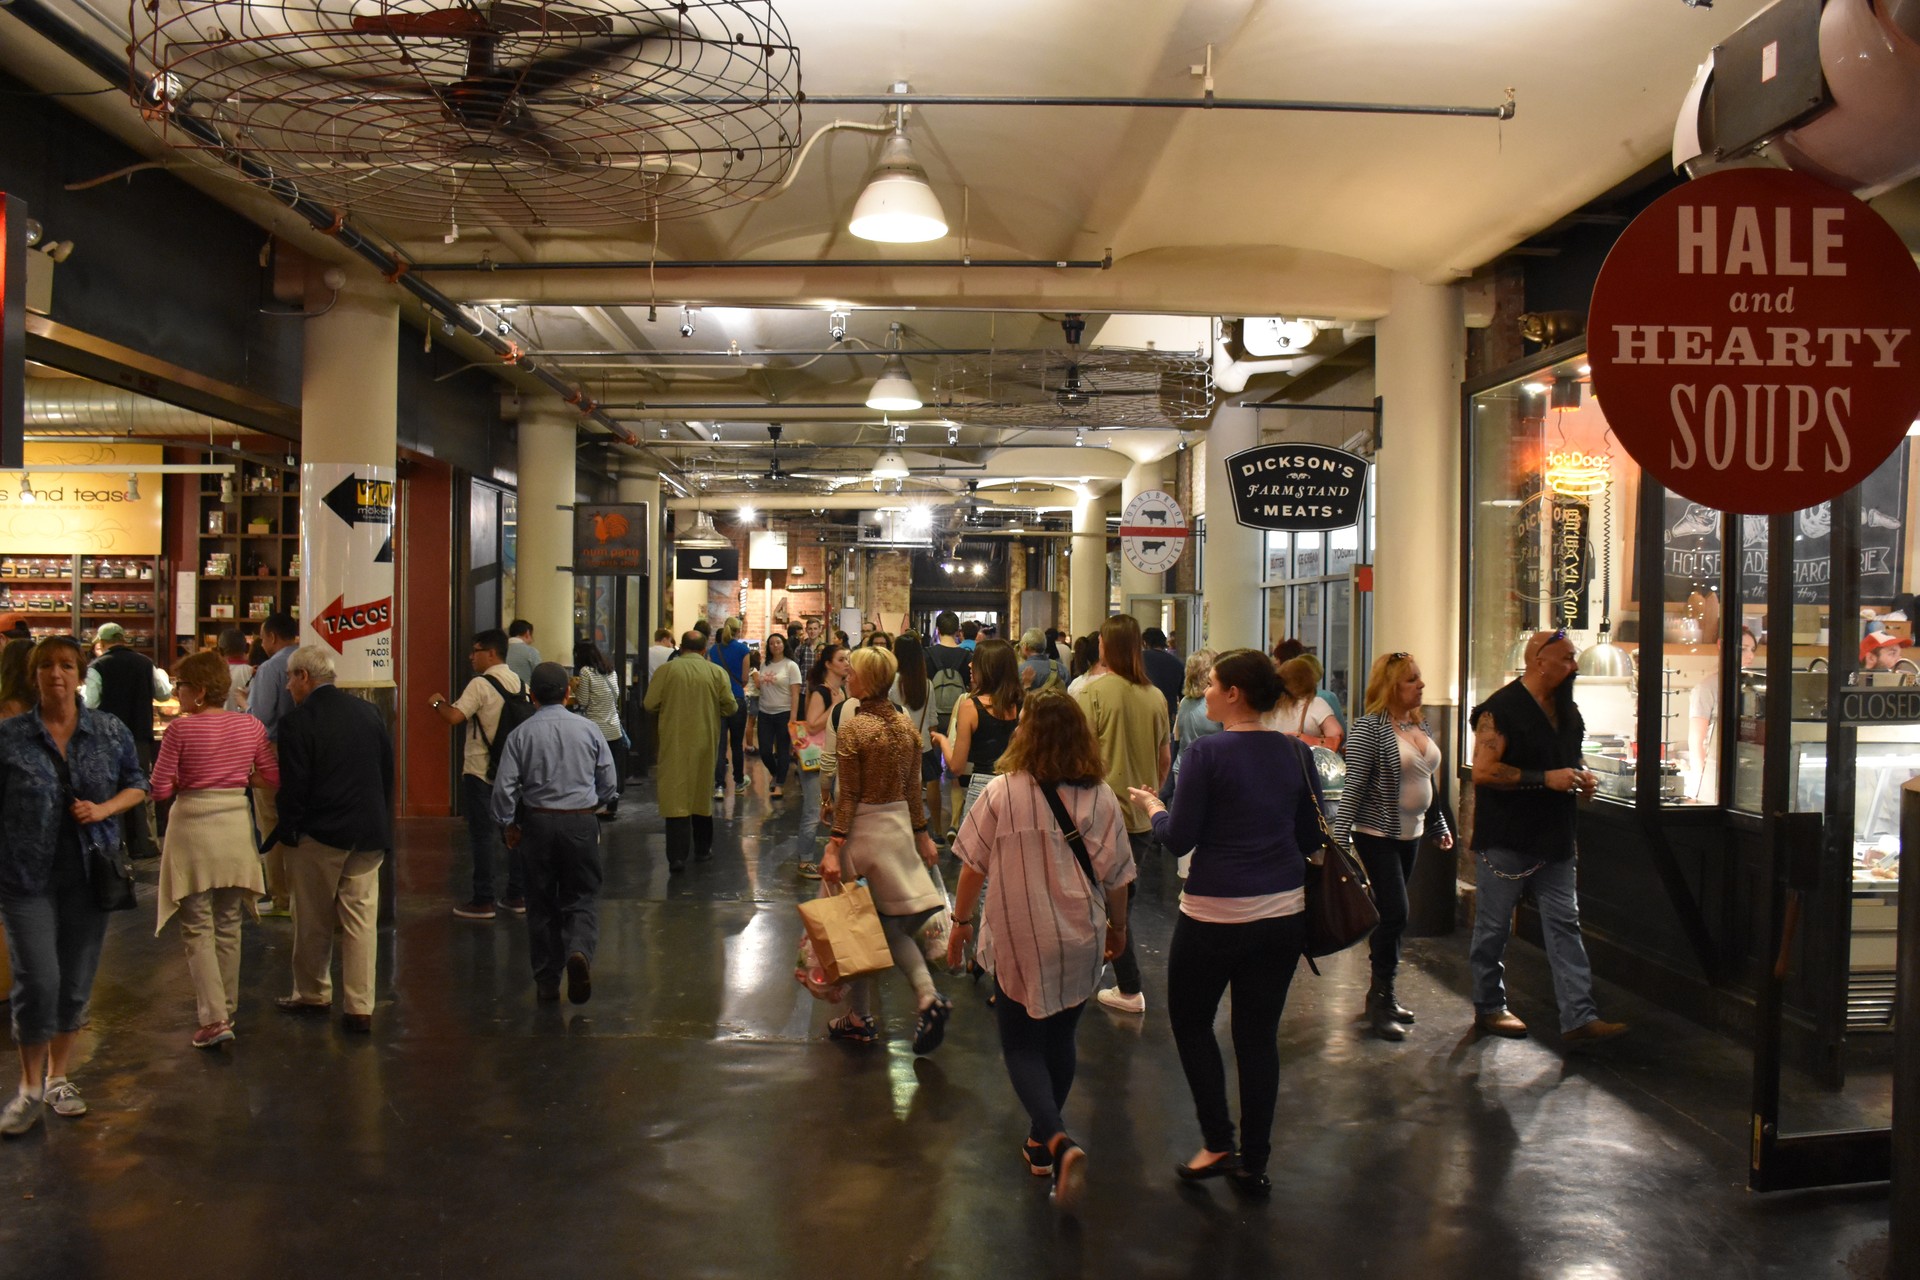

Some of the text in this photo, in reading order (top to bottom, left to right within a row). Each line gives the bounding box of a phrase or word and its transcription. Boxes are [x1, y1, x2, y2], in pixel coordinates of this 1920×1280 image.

[1678, 205, 1847, 277] HALE
[1729, 286, 1795, 314] and
[1611, 325, 1911, 368] HEARTY
[1670, 383, 1851, 474] SOUPS
[1241, 456, 1355, 479] DICKSON'S
[1246, 484, 1350, 499] FARMSTAND
[1263, 505, 1333, 518] MEATS
[322, 604, 389, 635] TACOS
[366, 648, 389, 657] TACOS
[377, 637, 389, 646] LOS
[1843, 693, 1920, 720] CLOSED
